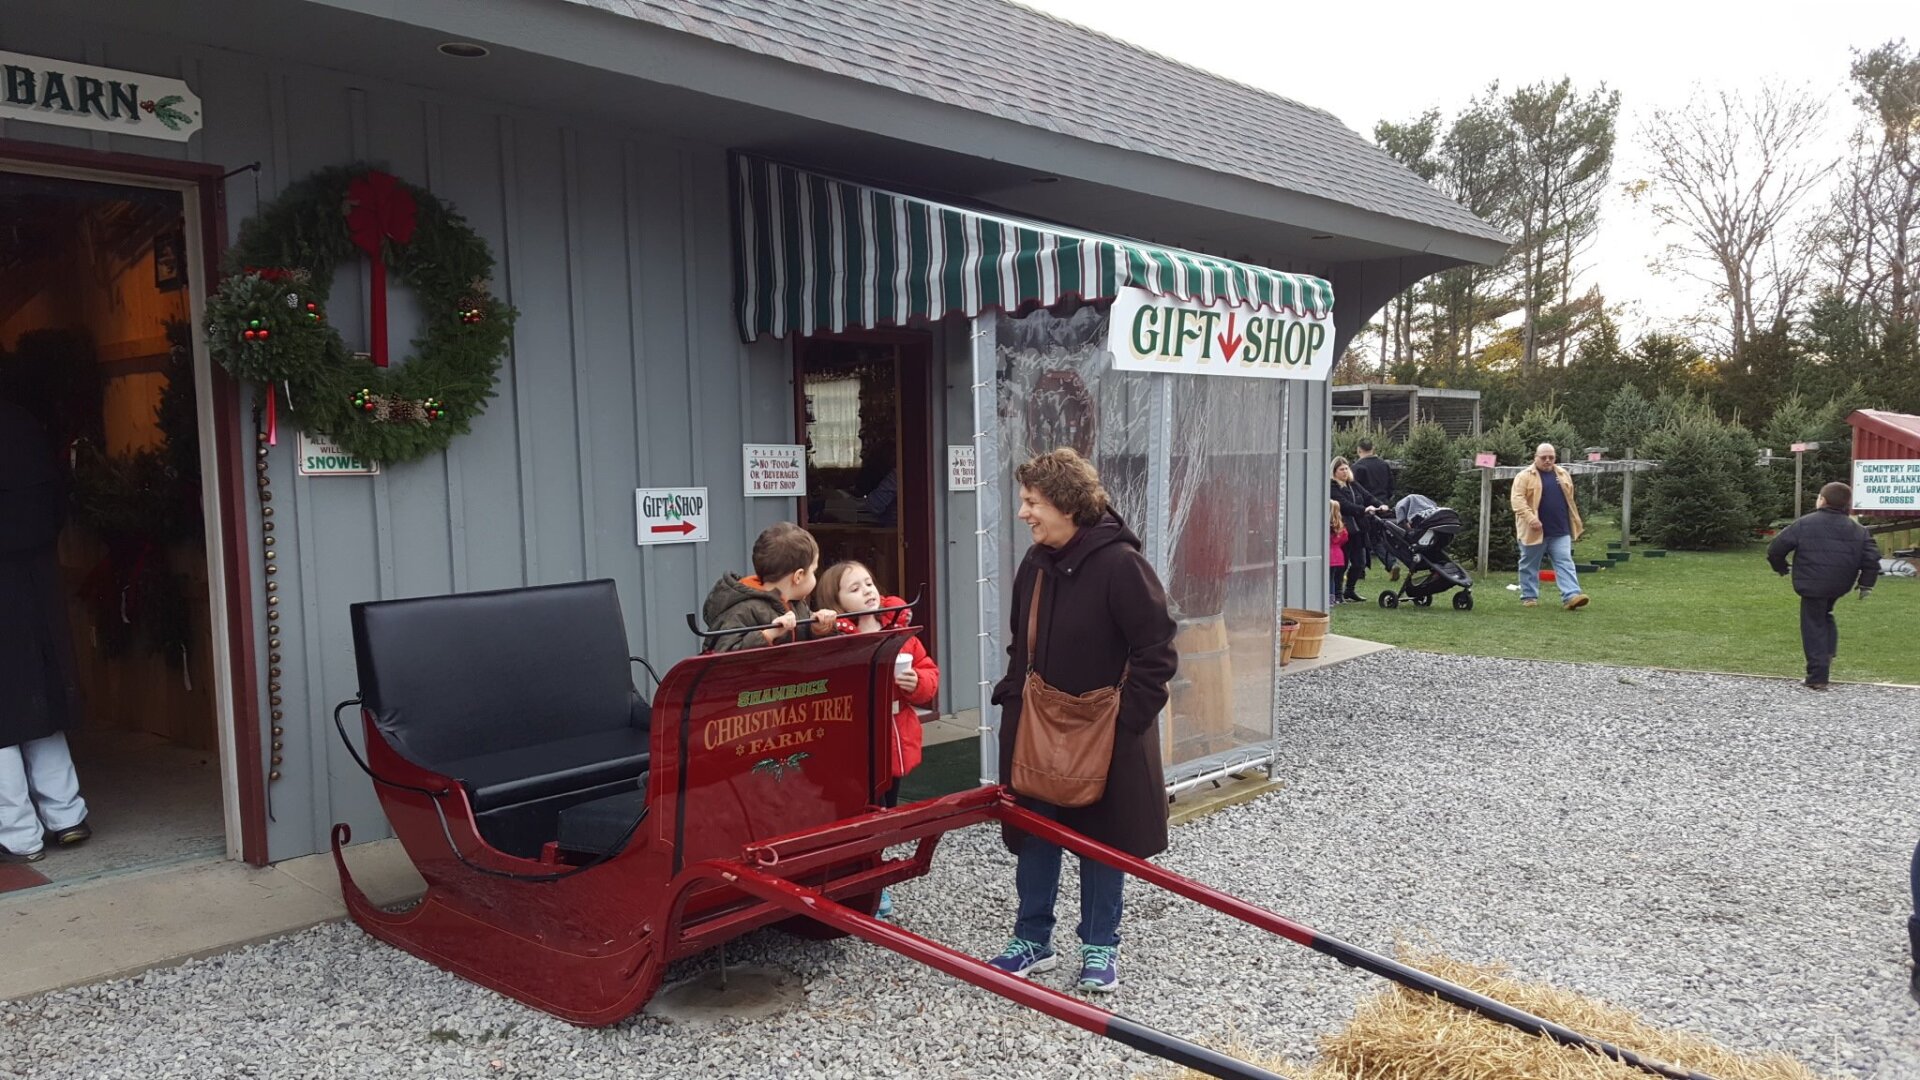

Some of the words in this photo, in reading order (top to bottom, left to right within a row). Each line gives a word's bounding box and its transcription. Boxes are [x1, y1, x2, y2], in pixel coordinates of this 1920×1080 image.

[2, 64, 141, 122] BARN
[1130, 304, 1221, 357] GIFT
[1242, 316, 1326, 367] SHOP
[759, 459, 769, 469] NO
[770, 459, 790, 469] FOOD
[1862, 465, 1905, 473] CEMETERY
[750, 470, 760, 479] OR
[762, 470, 799, 479] BEVERAGES
[1863, 475, 1888, 483] GRAVE
[753, 481, 761, 490] IN
[763, 481, 778, 490] GIFT
[780, 481, 796, 490] SHOP
[1866, 486, 1890, 494] GRAVE
[1879, 496, 1915, 504] CROSSES
[643, 495, 669, 518] GIFT
[675, 495, 703, 517] SHOP
[737, 679, 829, 707] SHAMROCK
[704, 702, 807, 750] CHRISTMAS
[812, 695, 853, 721] TREE
[749, 728, 814, 755] FARM
